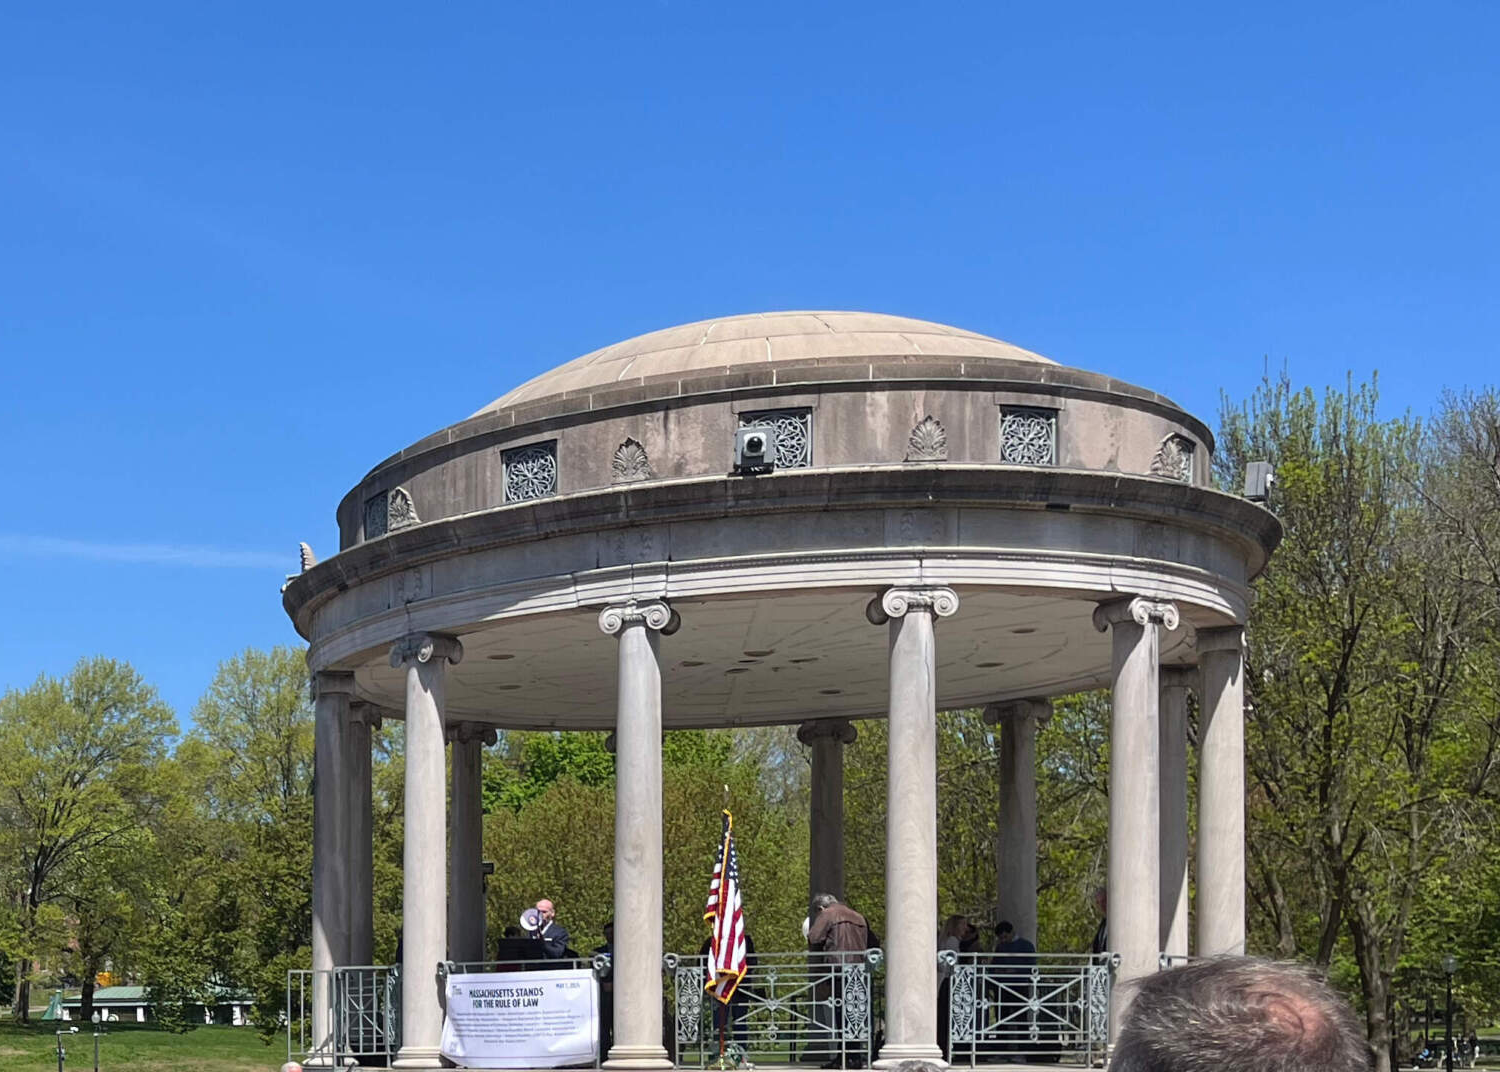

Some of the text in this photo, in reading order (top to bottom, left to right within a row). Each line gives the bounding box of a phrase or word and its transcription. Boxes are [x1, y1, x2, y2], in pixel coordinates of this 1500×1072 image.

[469, 988, 514, 999] MASSACHUSETTS
[515, 987, 544, 997] STANDS
[473, 998, 539, 1009] FOR THE RULE OF LAW
